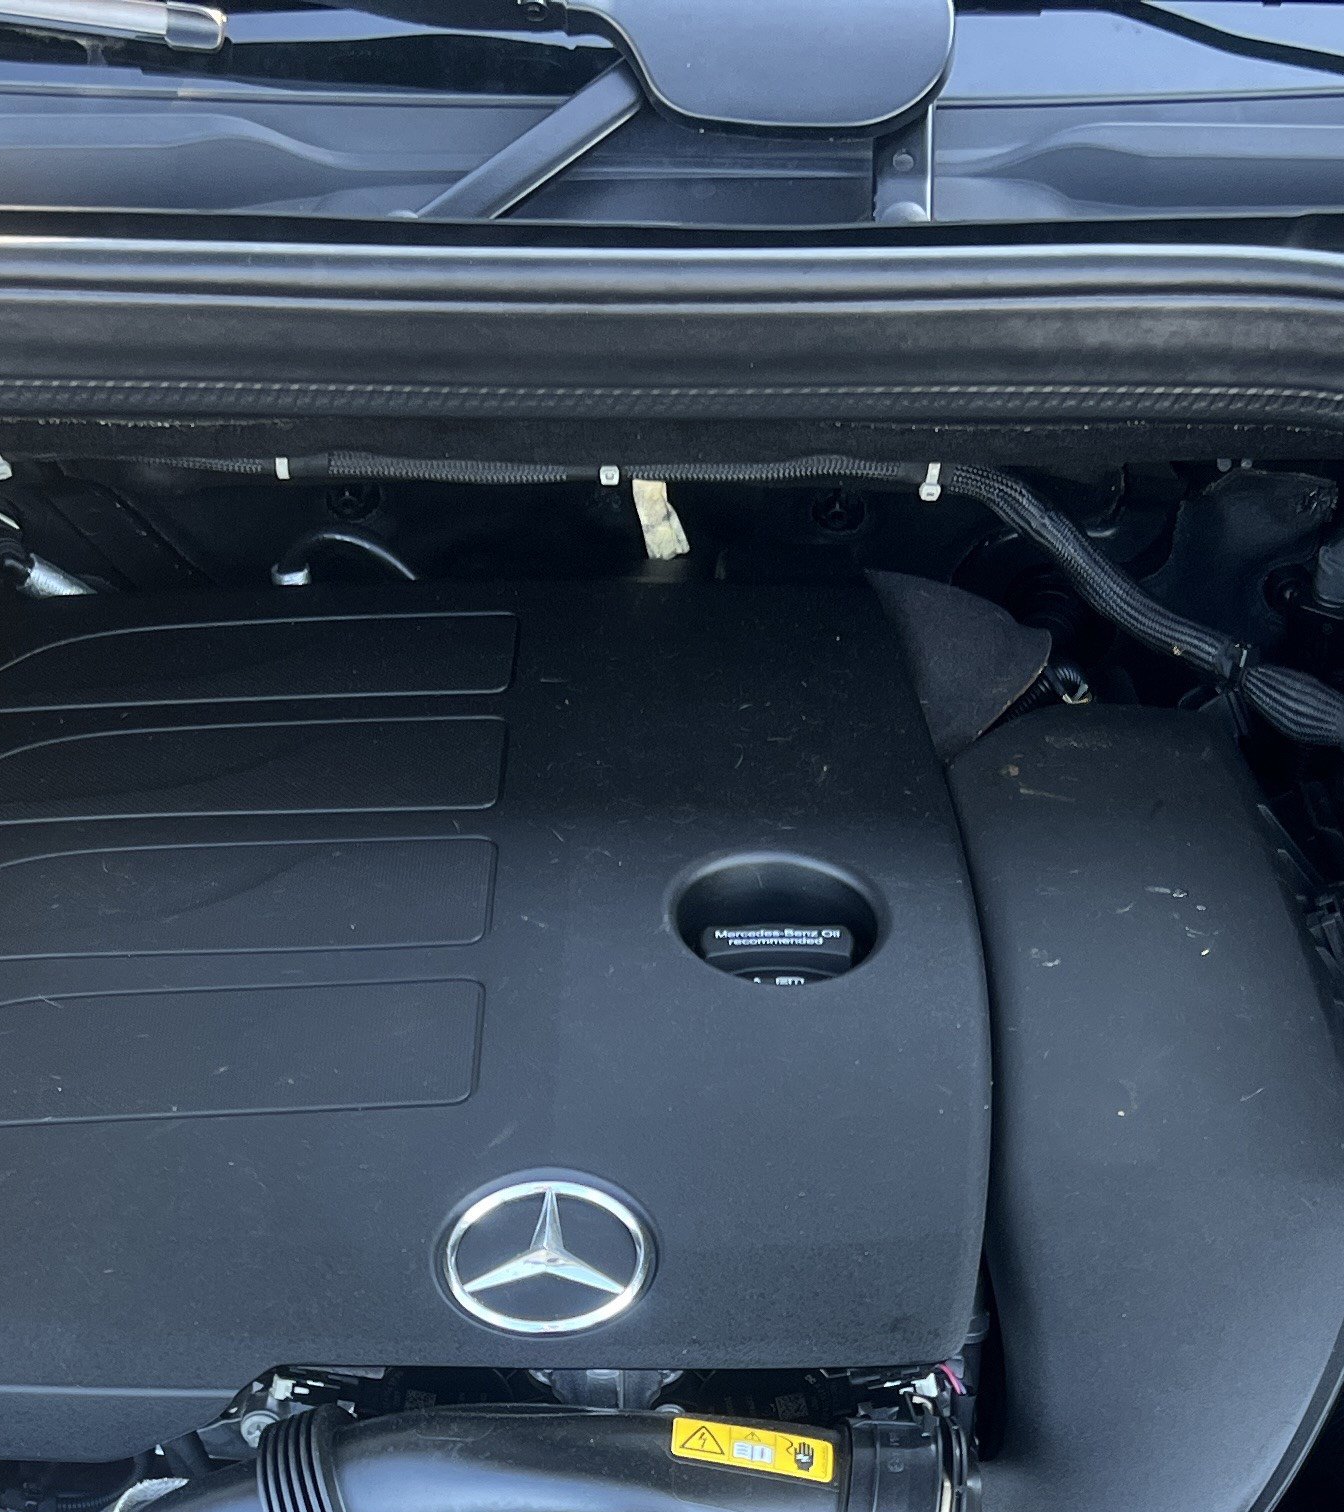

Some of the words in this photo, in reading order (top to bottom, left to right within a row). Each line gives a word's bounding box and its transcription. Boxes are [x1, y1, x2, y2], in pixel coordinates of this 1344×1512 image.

[714, 928, 819, 939] Mercedes-Benz
[821, 929, 841, 939] Oil
[728, 938, 824, 946] recommended
